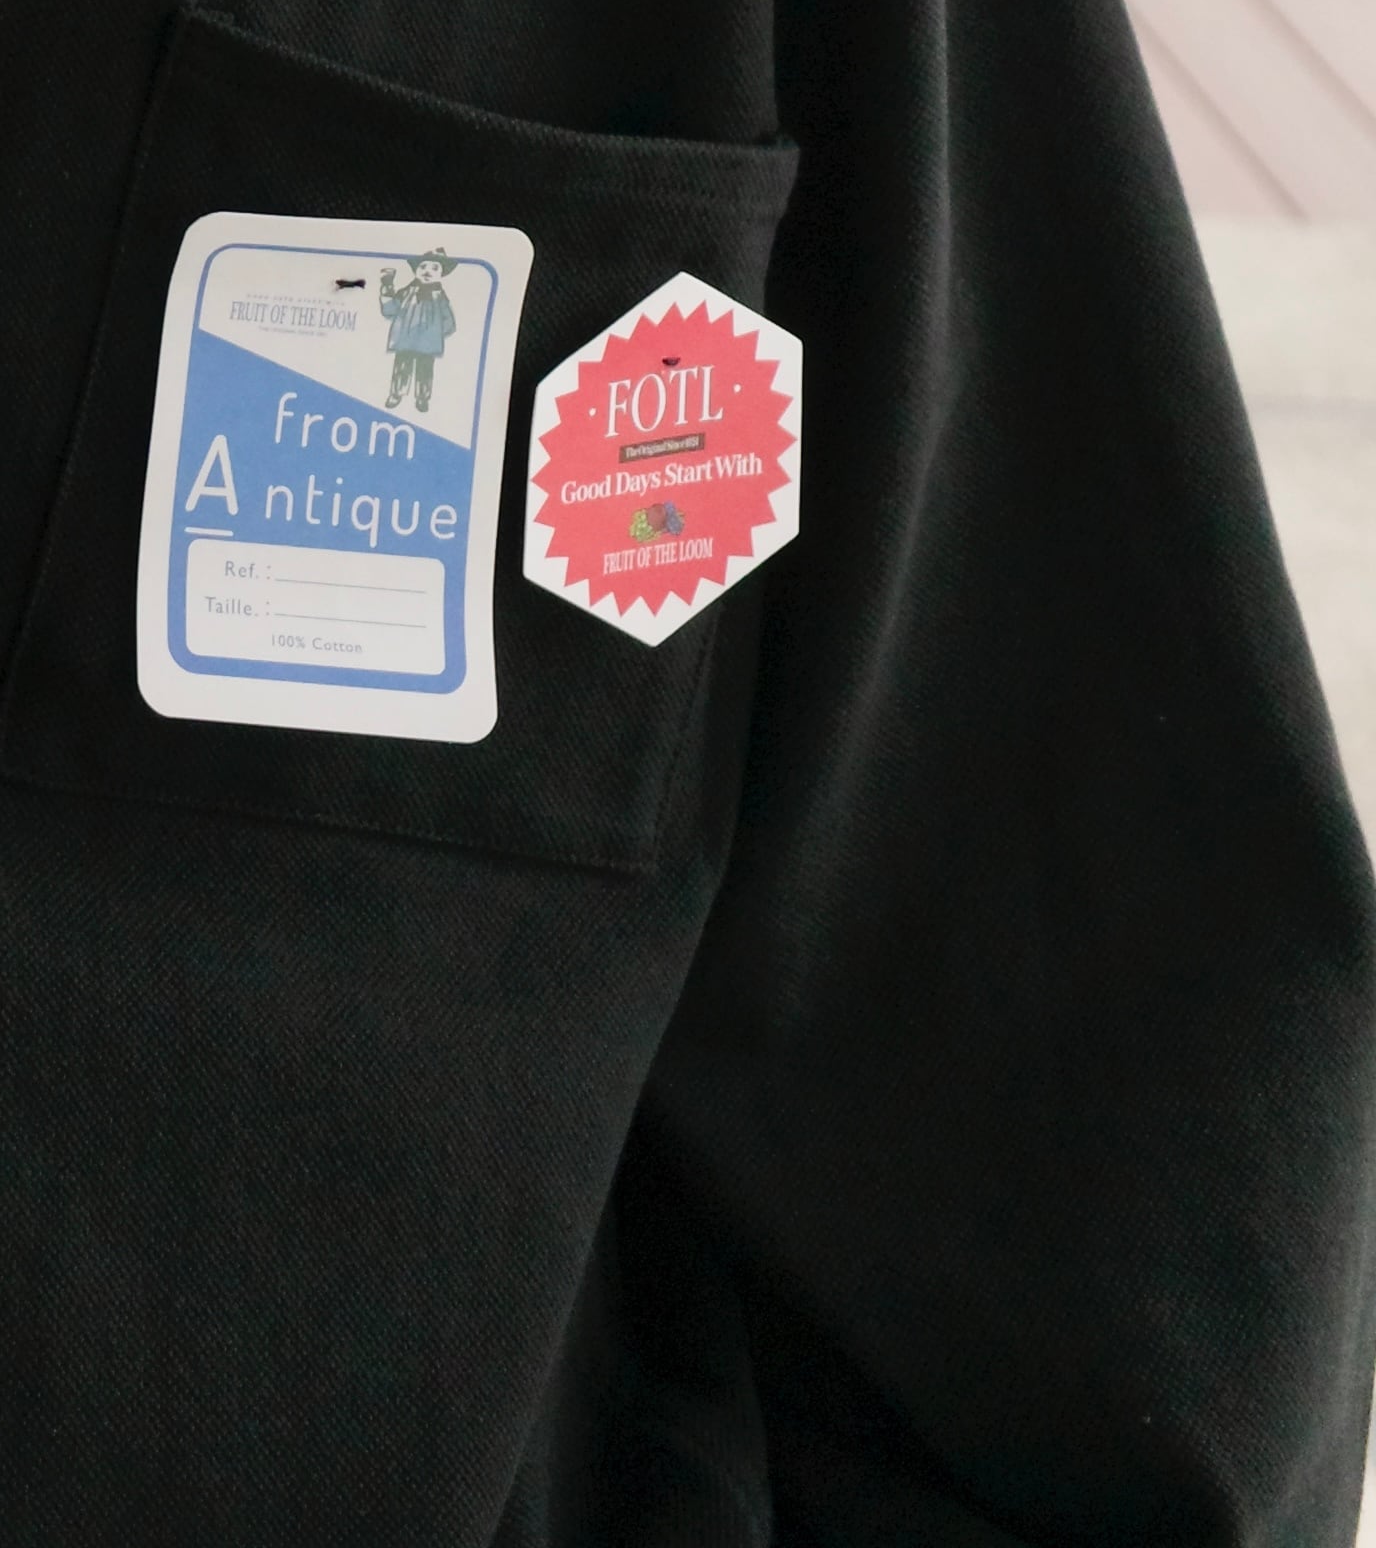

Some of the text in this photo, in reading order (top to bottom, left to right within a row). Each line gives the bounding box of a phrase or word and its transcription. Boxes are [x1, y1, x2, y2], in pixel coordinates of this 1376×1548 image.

[229, 300, 267, 323] FRUIT
[270, 304, 288, 325] OF
[290, 305, 317, 327] THE
[318, 308, 358, 331] LOOM
[604, 364, 724, 438] FOTL
[273, 392, 416, 461] from
[561, 452, 763, 505] Good Days Start With
[602, 538, 714, 576] FRUIT OF THE LOOM
[271, 633, 364, 654] 100% Cotton
